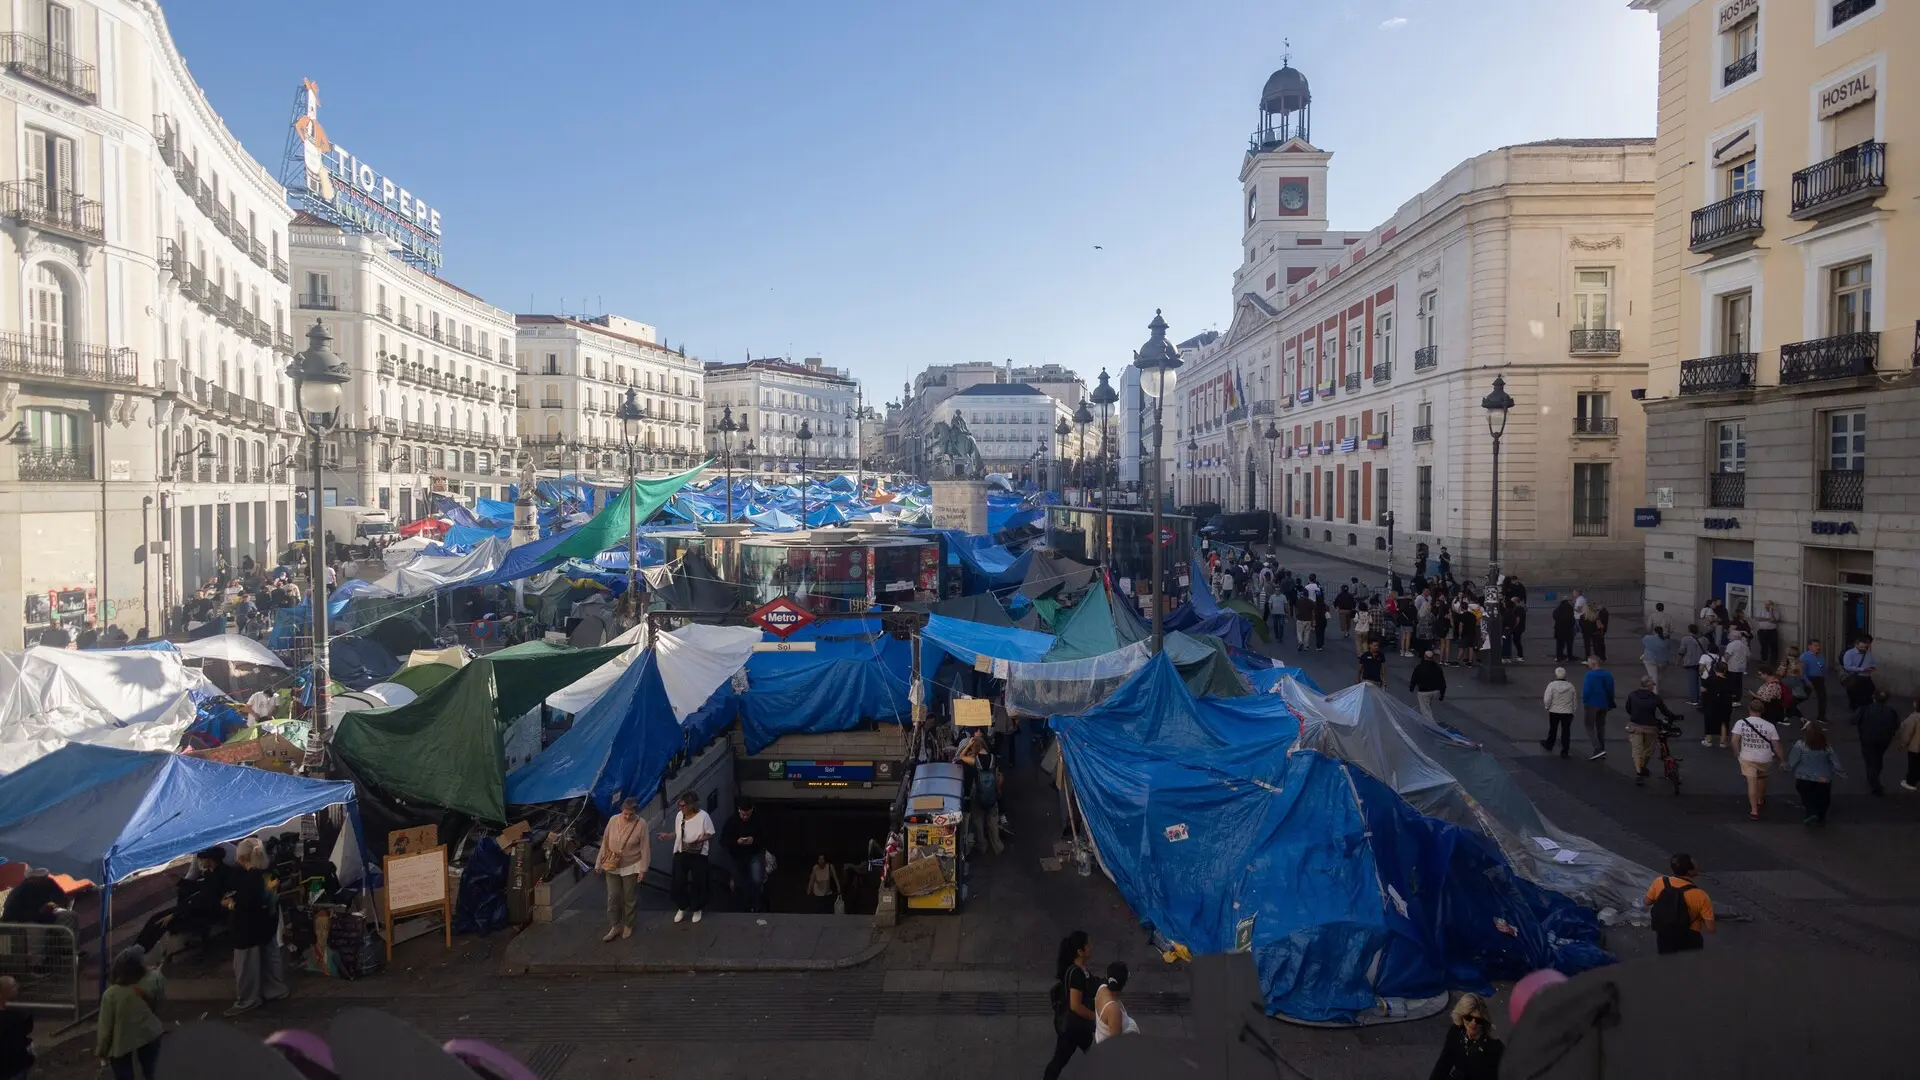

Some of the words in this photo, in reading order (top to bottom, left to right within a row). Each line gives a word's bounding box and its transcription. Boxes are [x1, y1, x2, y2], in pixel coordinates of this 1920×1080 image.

[1822, 75, 1870, 109] HOSTAL
[334, 143, 375, 193] TIO
[382, 176, 442, 235] PEPE
[1703, 517, 1740, 530] BBVA
[1811, 520, 1858, 535] BBVA
[768, 613, 796, 623] Metro
